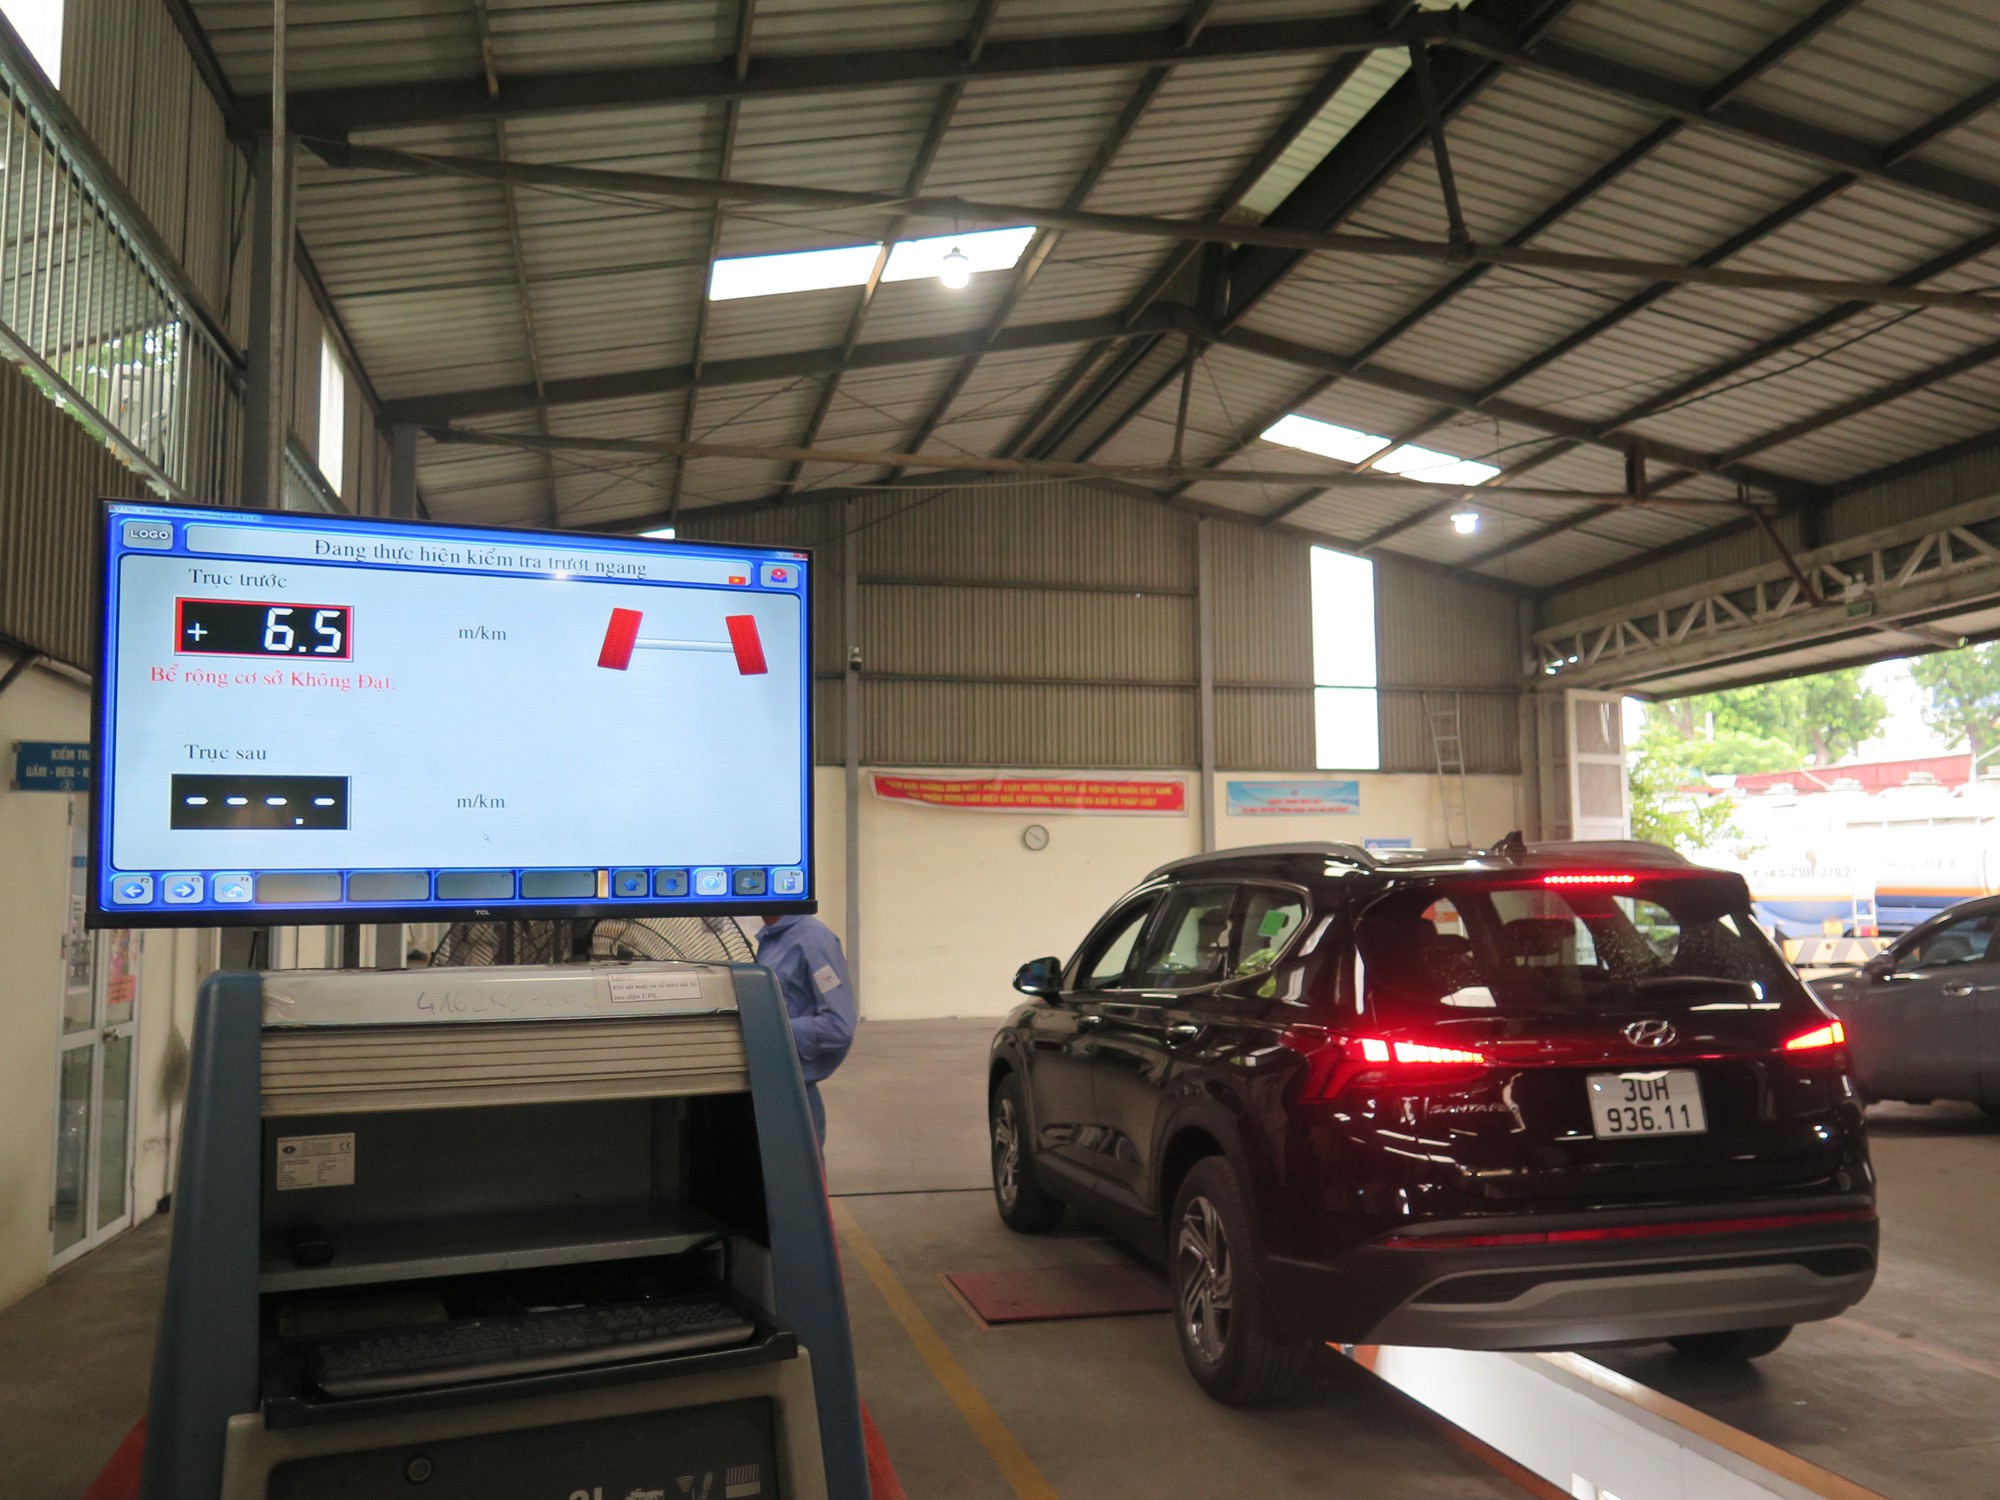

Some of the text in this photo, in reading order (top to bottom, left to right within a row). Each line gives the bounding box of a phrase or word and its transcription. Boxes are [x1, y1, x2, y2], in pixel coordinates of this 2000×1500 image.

[130, 529, 169, 540] LOGO
[315, 539, 647, 579] Đang thực hiện kiểm tra trượt ngang
[188, 568, 287, 589] Trục trước
[264, 607, 342, 654] 6.5
[458, 625, 507, 641] m/km
[185, 668, 228, 688] rộng
[234, 672, 257, 684] cơ
[263, 669, 283, 685] sở
[291, 672, 351, 692] Không
[184, 743, 267, 763] Trục sau
[457, 793, 505, 809] m/km
[1621, 1075, 1669, 1102] 30H
[1607, 1104, 1690, 1132] 936.11
